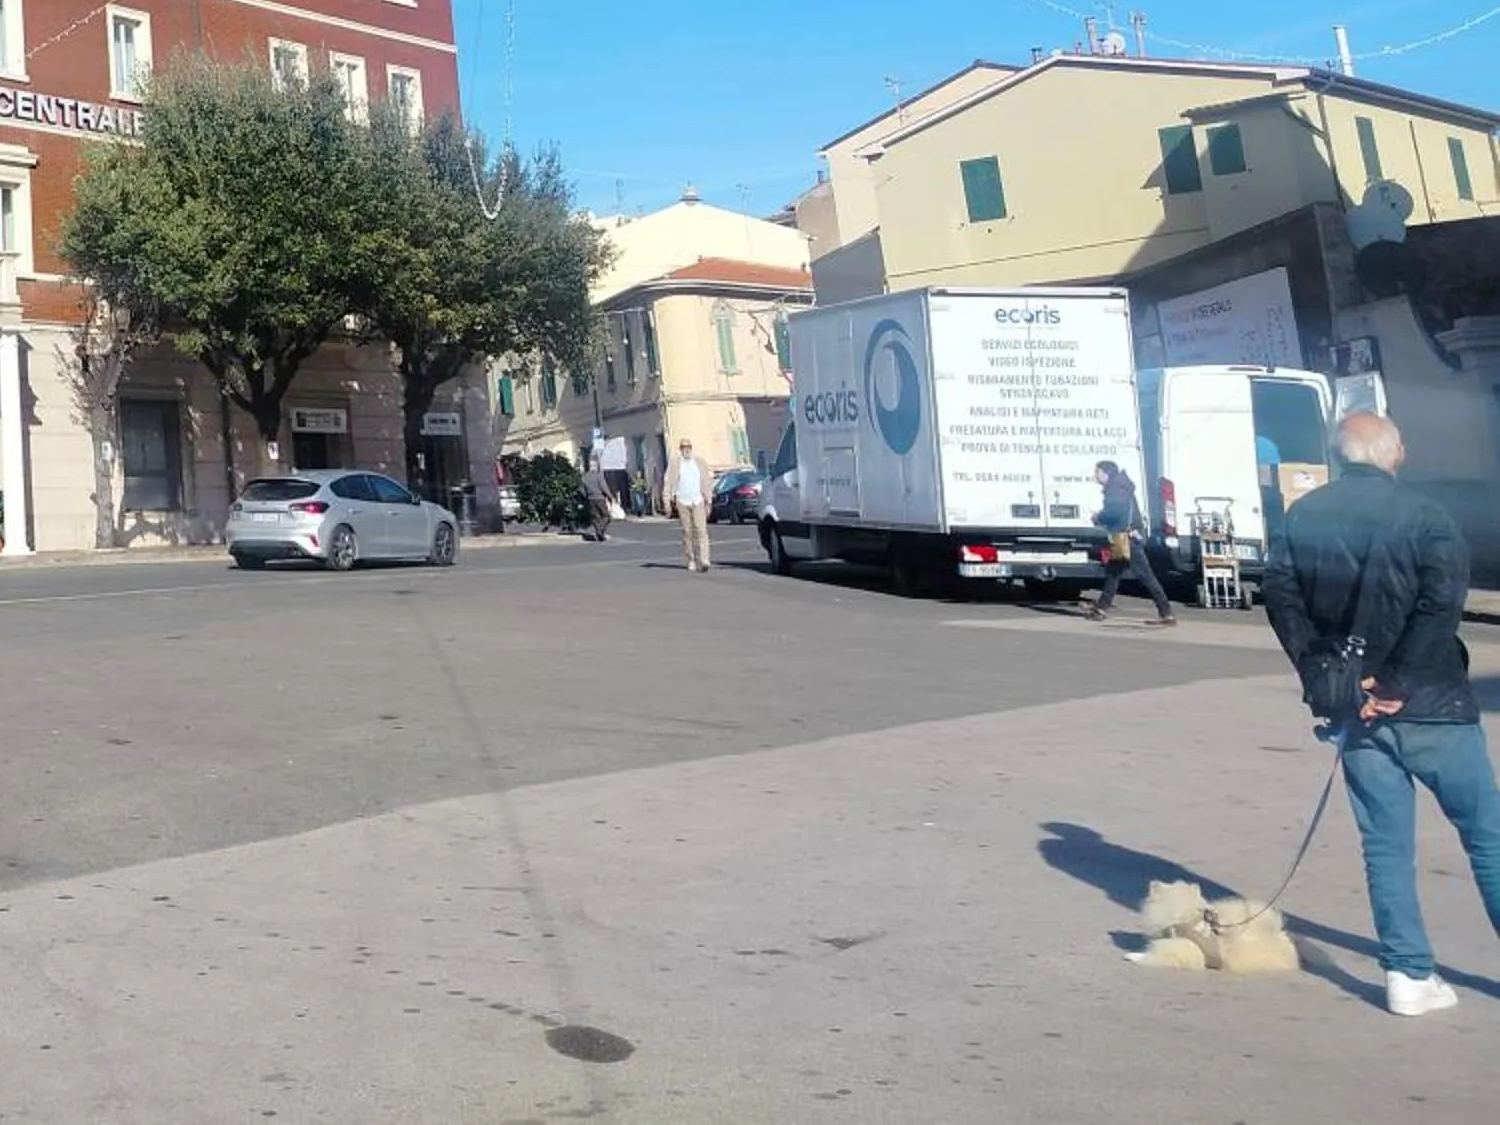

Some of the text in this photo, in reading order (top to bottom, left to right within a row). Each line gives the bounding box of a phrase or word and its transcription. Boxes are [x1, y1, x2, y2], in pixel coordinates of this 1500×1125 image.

[994, 305, 1061, 324] ecoris
[981, 339, 1021, 350] SERVIZI
[988, 356, 1019, 367] VIDEO
[804, 379, 859, 424] ecoris
[969, 406, 1011, 417] ANALISI
[961, 442, 997, 453] PROVA
